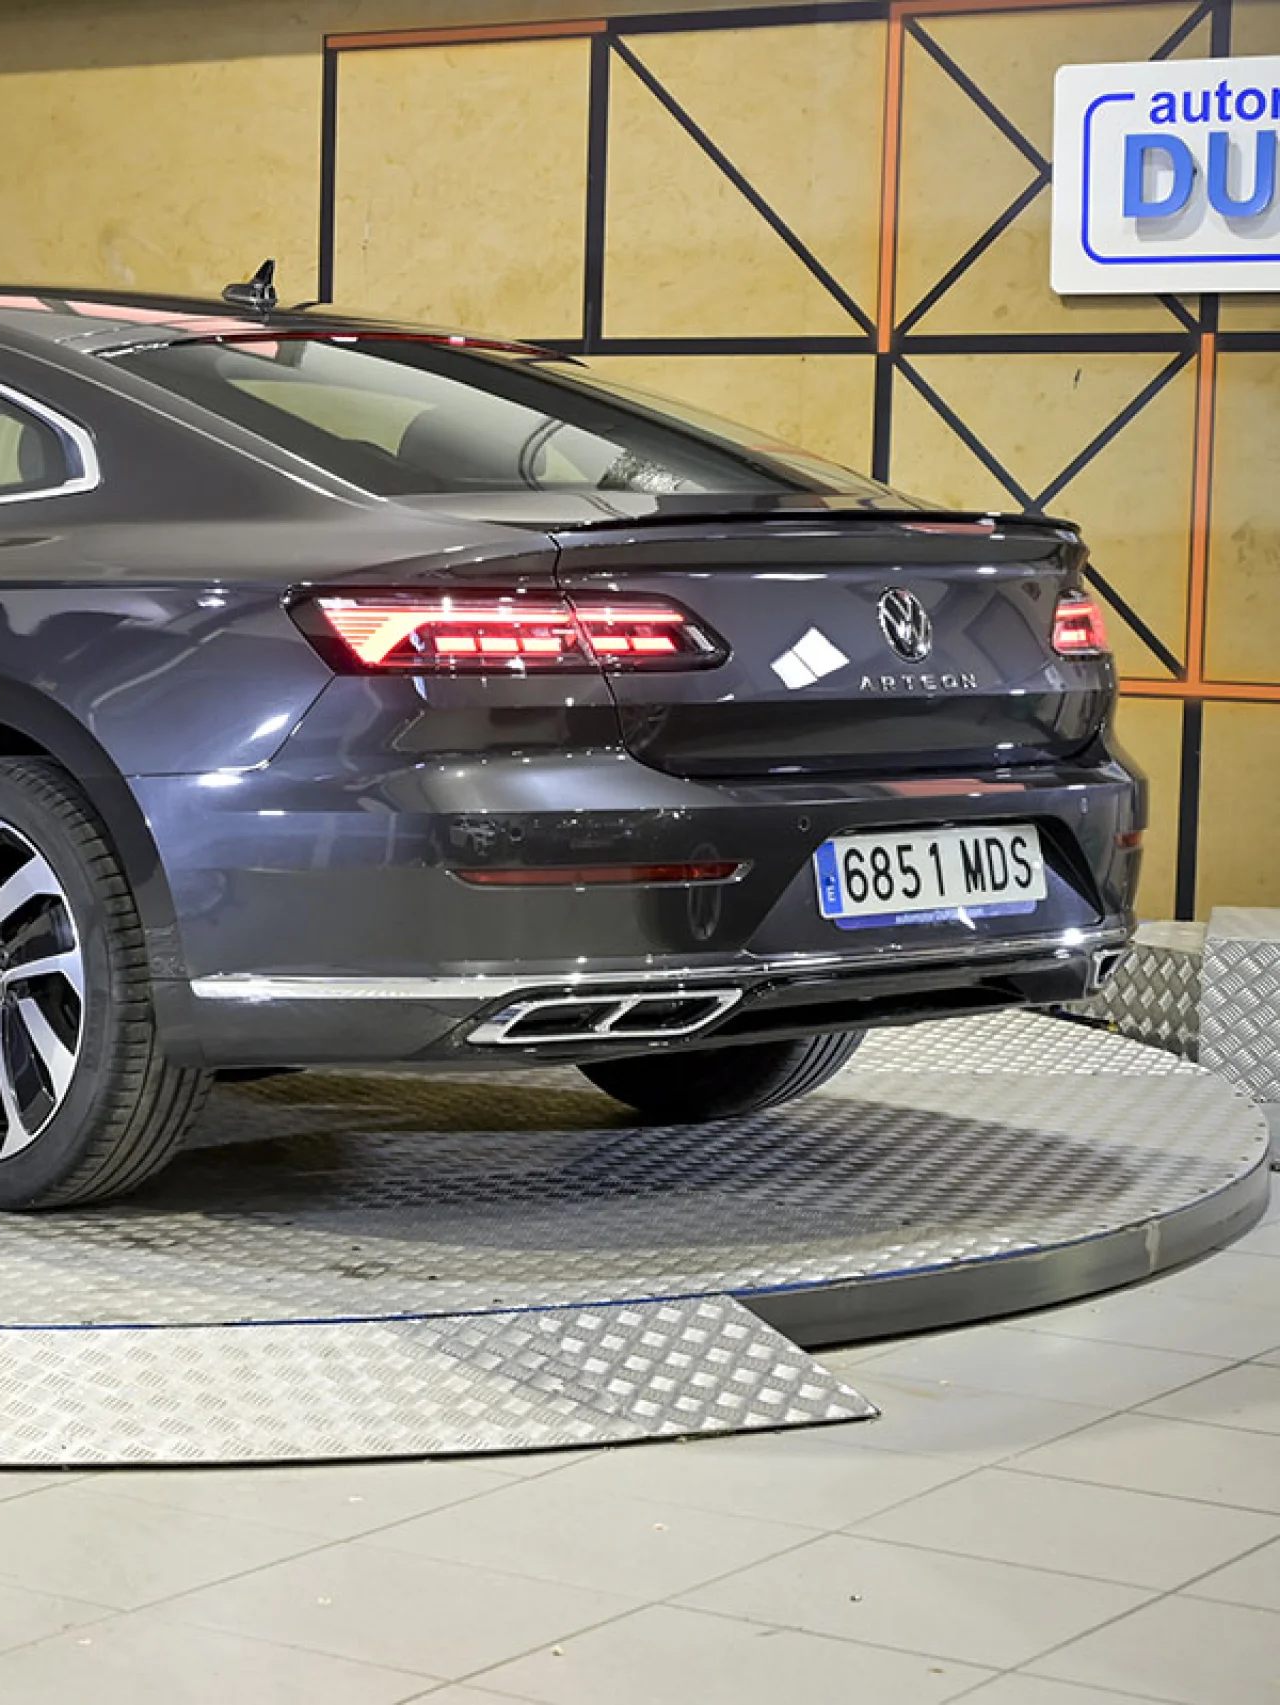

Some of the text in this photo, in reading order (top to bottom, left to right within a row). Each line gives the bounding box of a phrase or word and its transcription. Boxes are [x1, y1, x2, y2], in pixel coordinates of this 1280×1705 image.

[859, 674, 978, 693] ARTEON
[843, 836, 1032, 903] 6851 MDS
